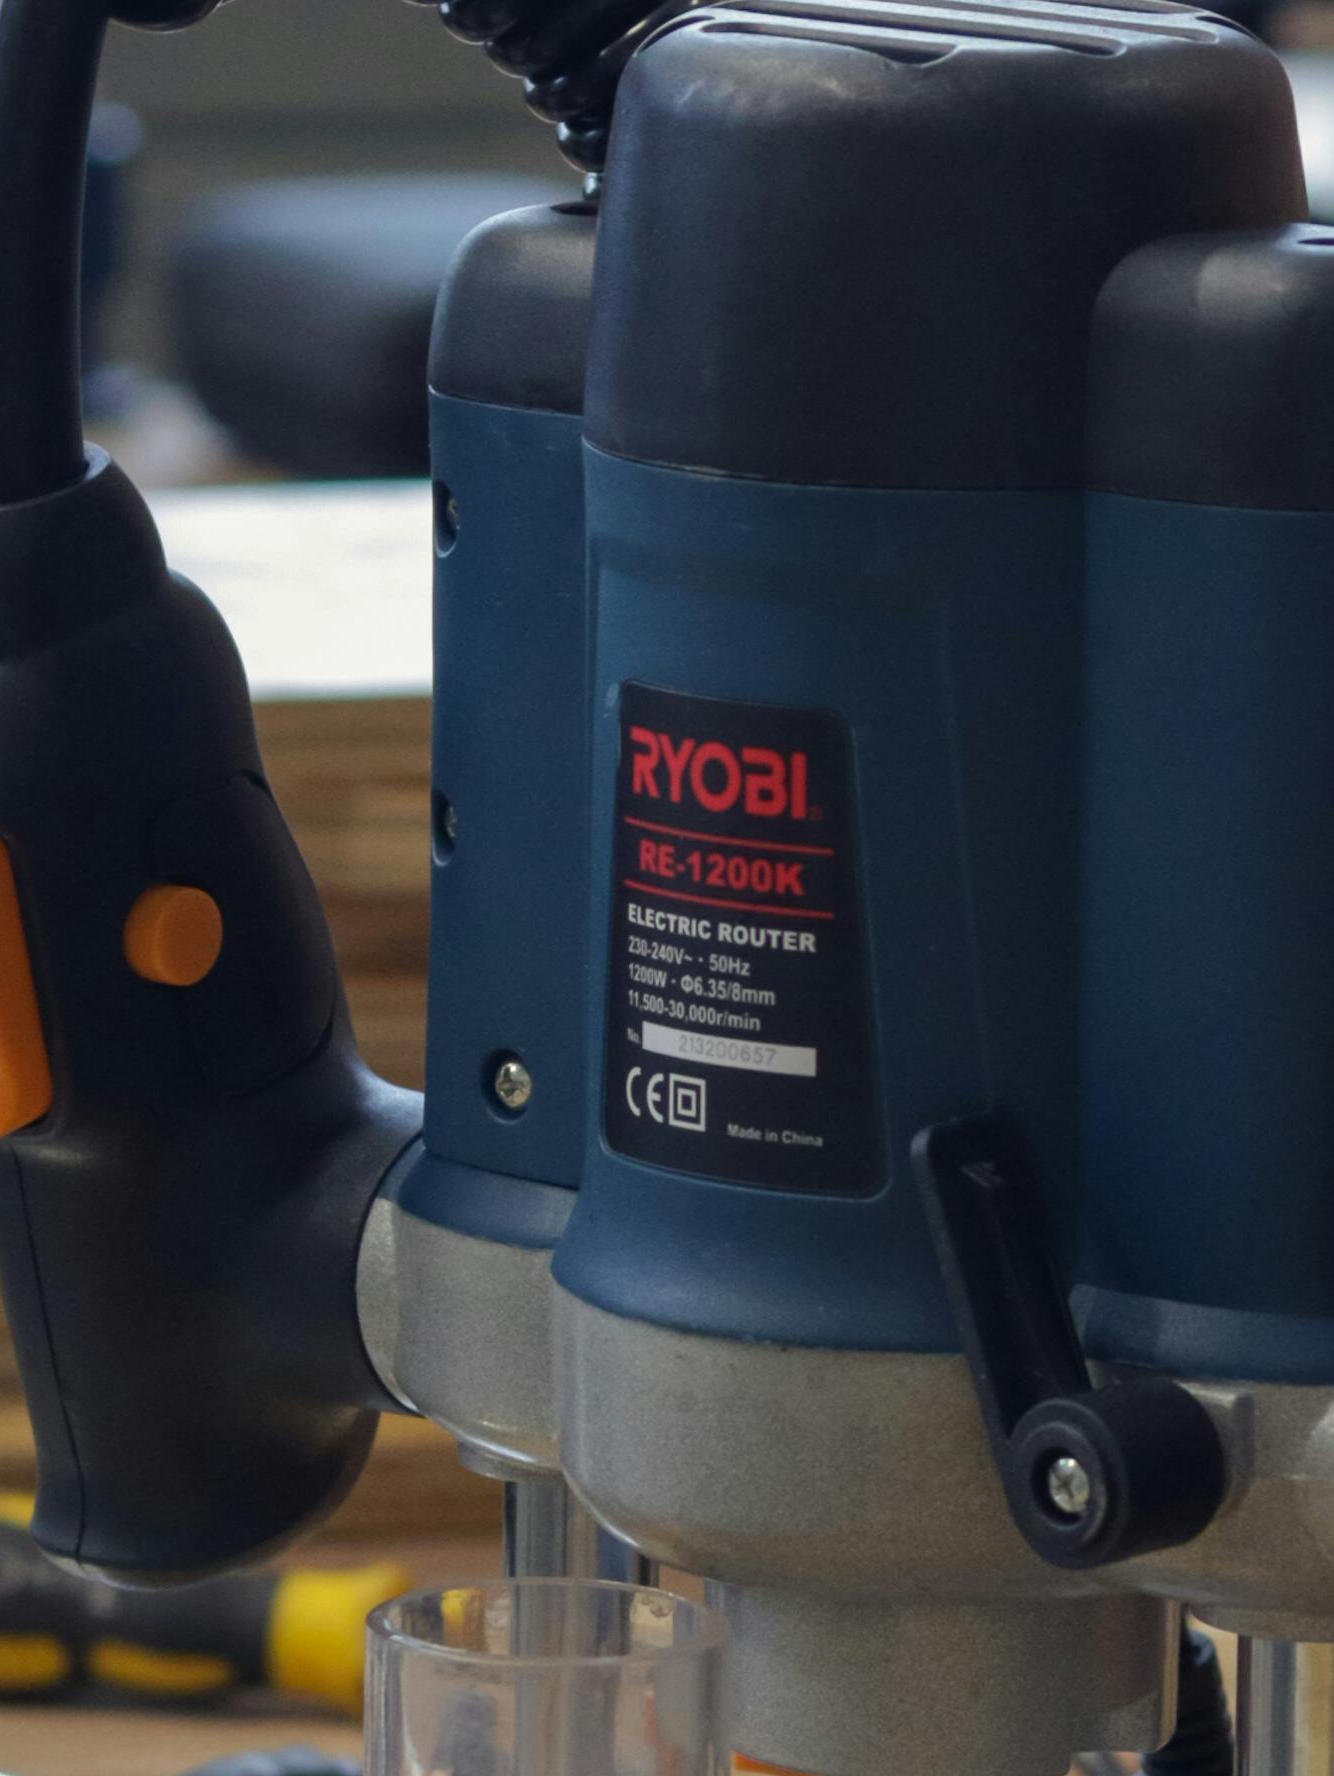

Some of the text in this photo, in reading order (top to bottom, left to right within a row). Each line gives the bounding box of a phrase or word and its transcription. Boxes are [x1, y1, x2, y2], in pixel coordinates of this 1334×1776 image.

[630, 726, 807, 819] RYOBI
[639, 839, 805, 895] RE-1200K
[628, 903, 816, 953] ELECTRIC ROUTER
[629, 963, 667, 988] 1200W
[709, 954, 750, 976] 50Hz
[678, 1034, 777, 1067] 213200657
[626, 1066, 665, 1124] CE
[727, 1124, 824, 1147] Made in China
